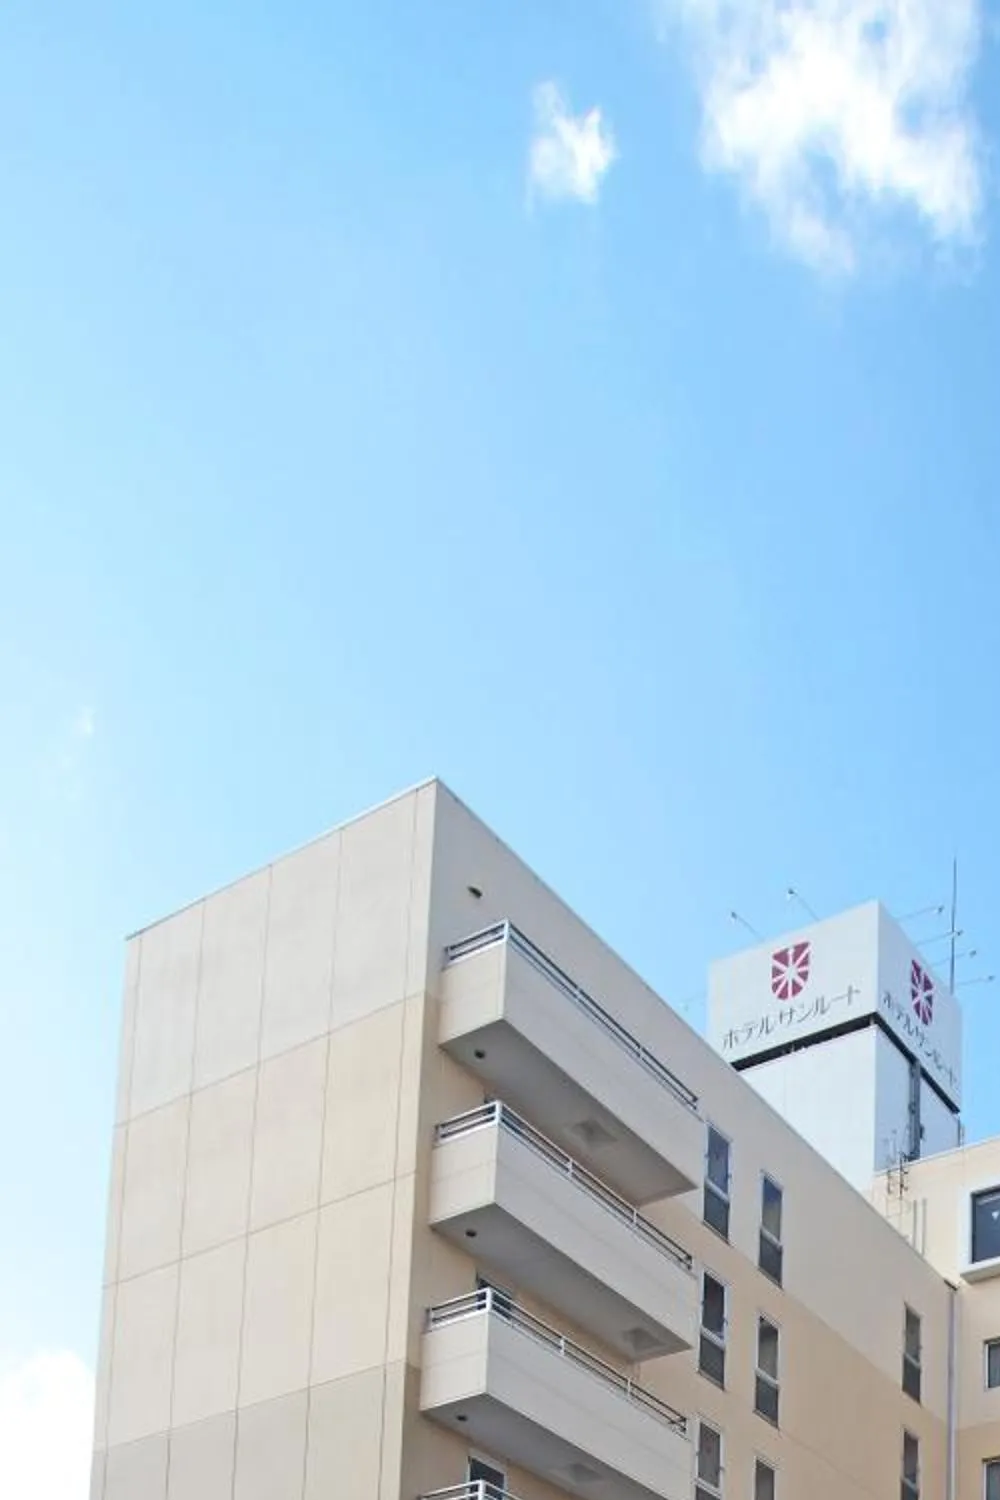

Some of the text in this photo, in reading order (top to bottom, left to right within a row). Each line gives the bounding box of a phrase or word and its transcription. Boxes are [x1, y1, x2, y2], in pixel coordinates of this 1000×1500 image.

[723, 985, 861, 1049] ホテルサンルート
